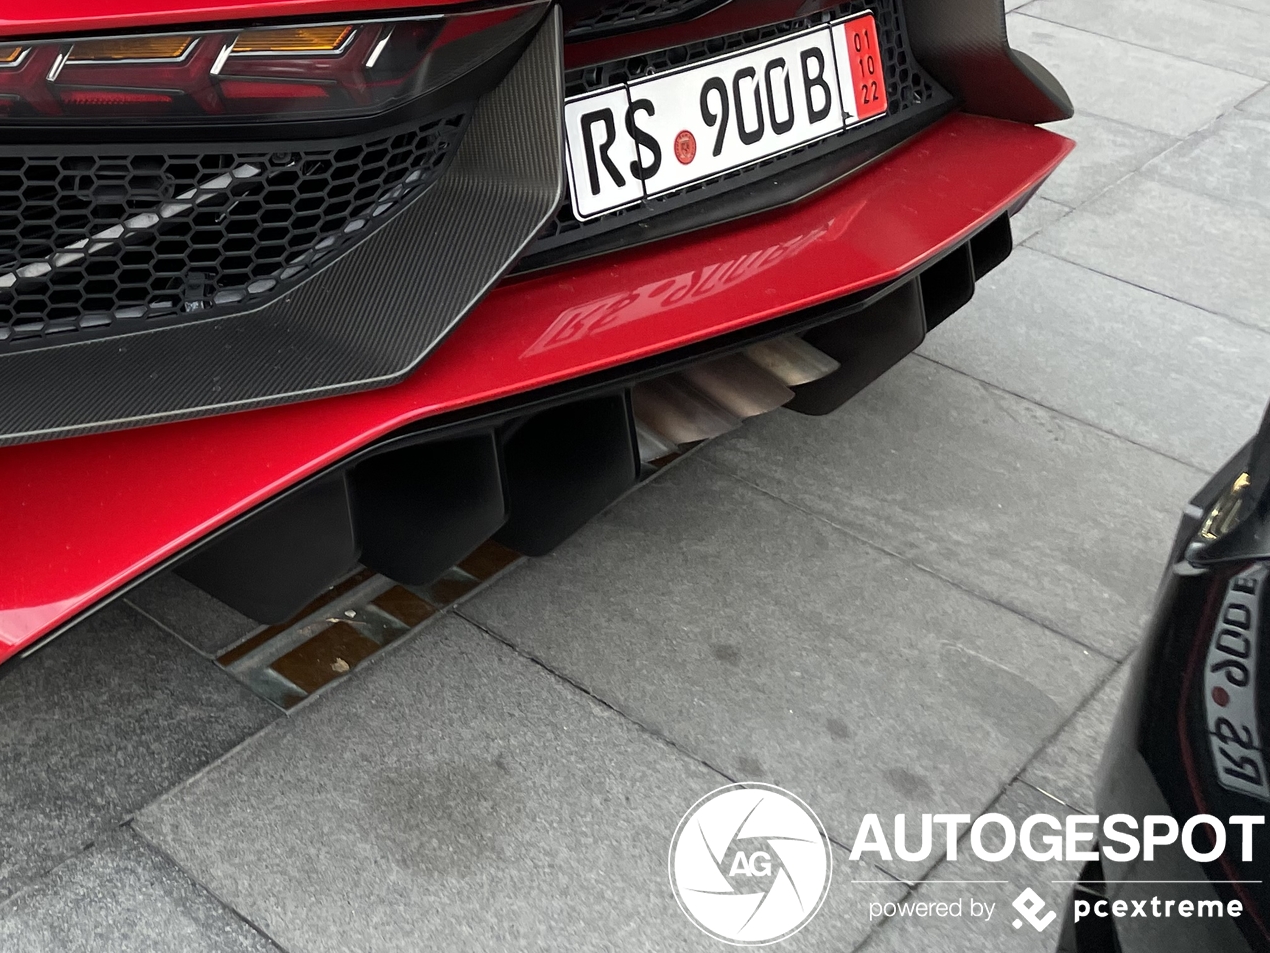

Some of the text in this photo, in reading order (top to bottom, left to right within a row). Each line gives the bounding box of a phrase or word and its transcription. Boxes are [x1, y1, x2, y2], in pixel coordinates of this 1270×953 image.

[853, 29, 870, 53] 01
[859, 54, 875, 78] 10
[862, 80, 879, 105] 22
[580, 46, 832, 197] RS 900 B
